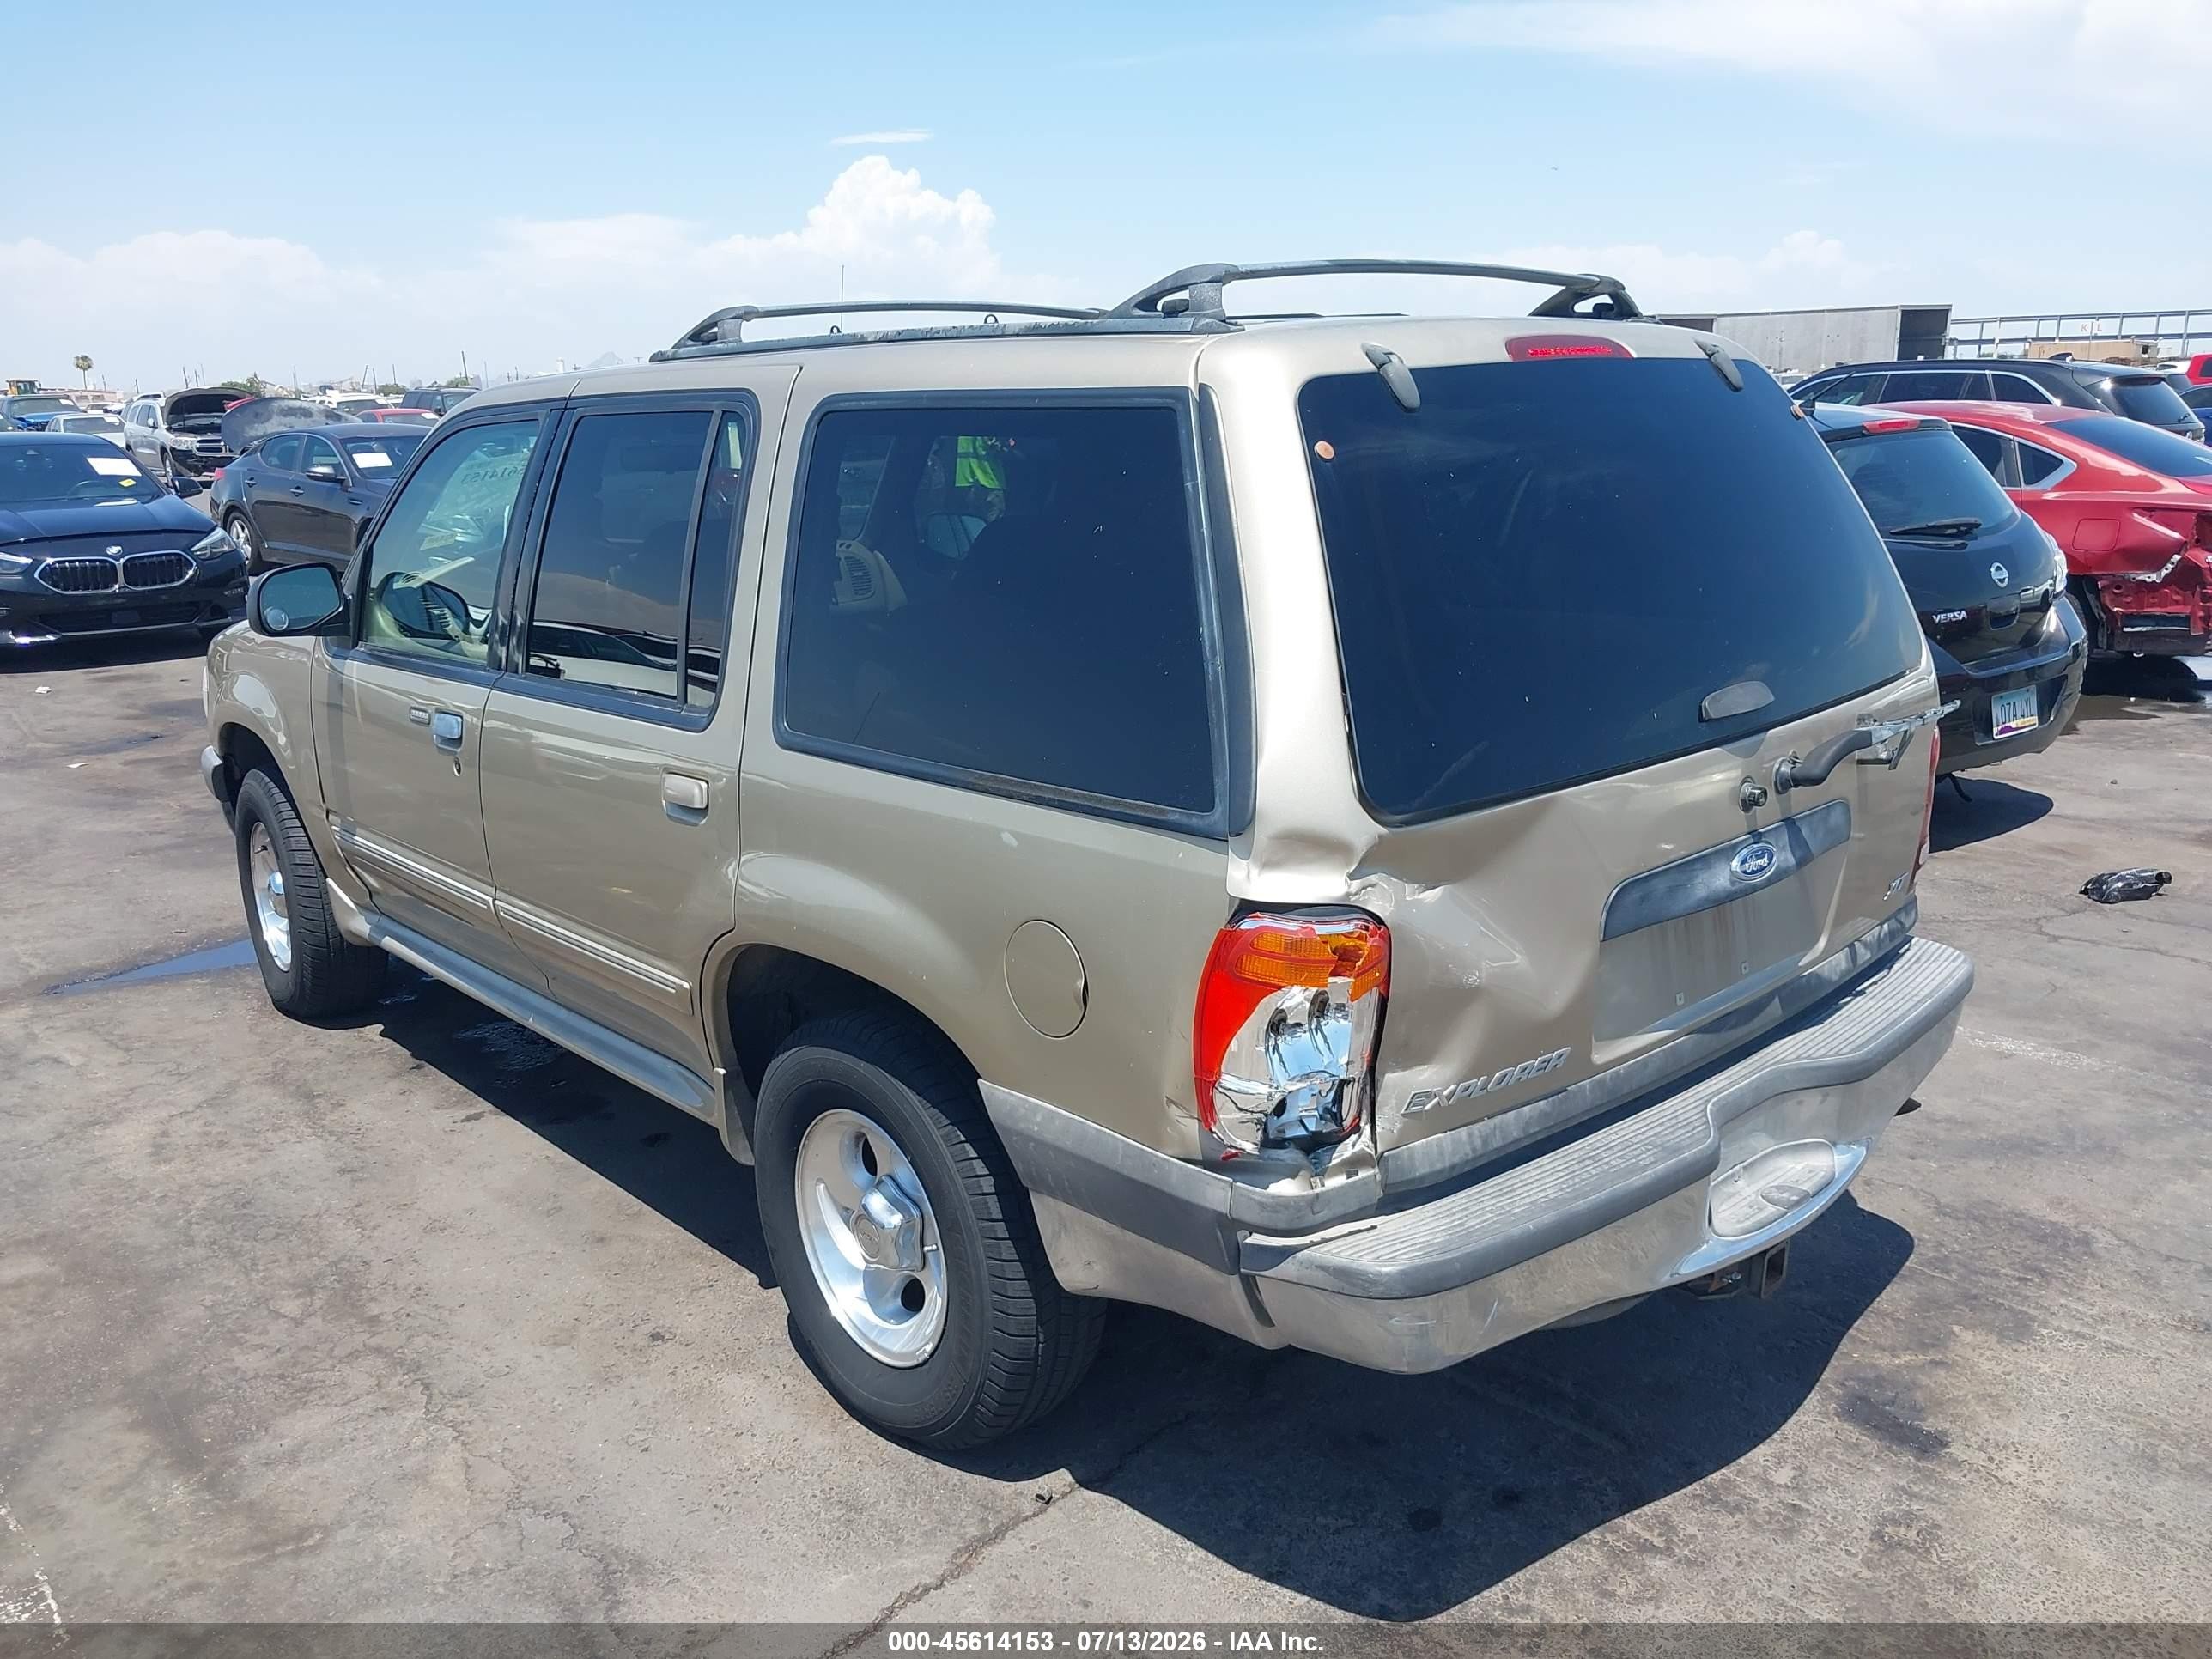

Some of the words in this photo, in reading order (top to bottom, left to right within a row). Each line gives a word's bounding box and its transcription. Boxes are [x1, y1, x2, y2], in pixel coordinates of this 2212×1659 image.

[2081, 323, 2089, 332] K
[2097, 323, 2103, 331] L
[1932, 610, 1968, 624] VERSA
[1741, 851, 1770, 873] Ford
[1401, 1046, 1571, 1115] EXPLORER
